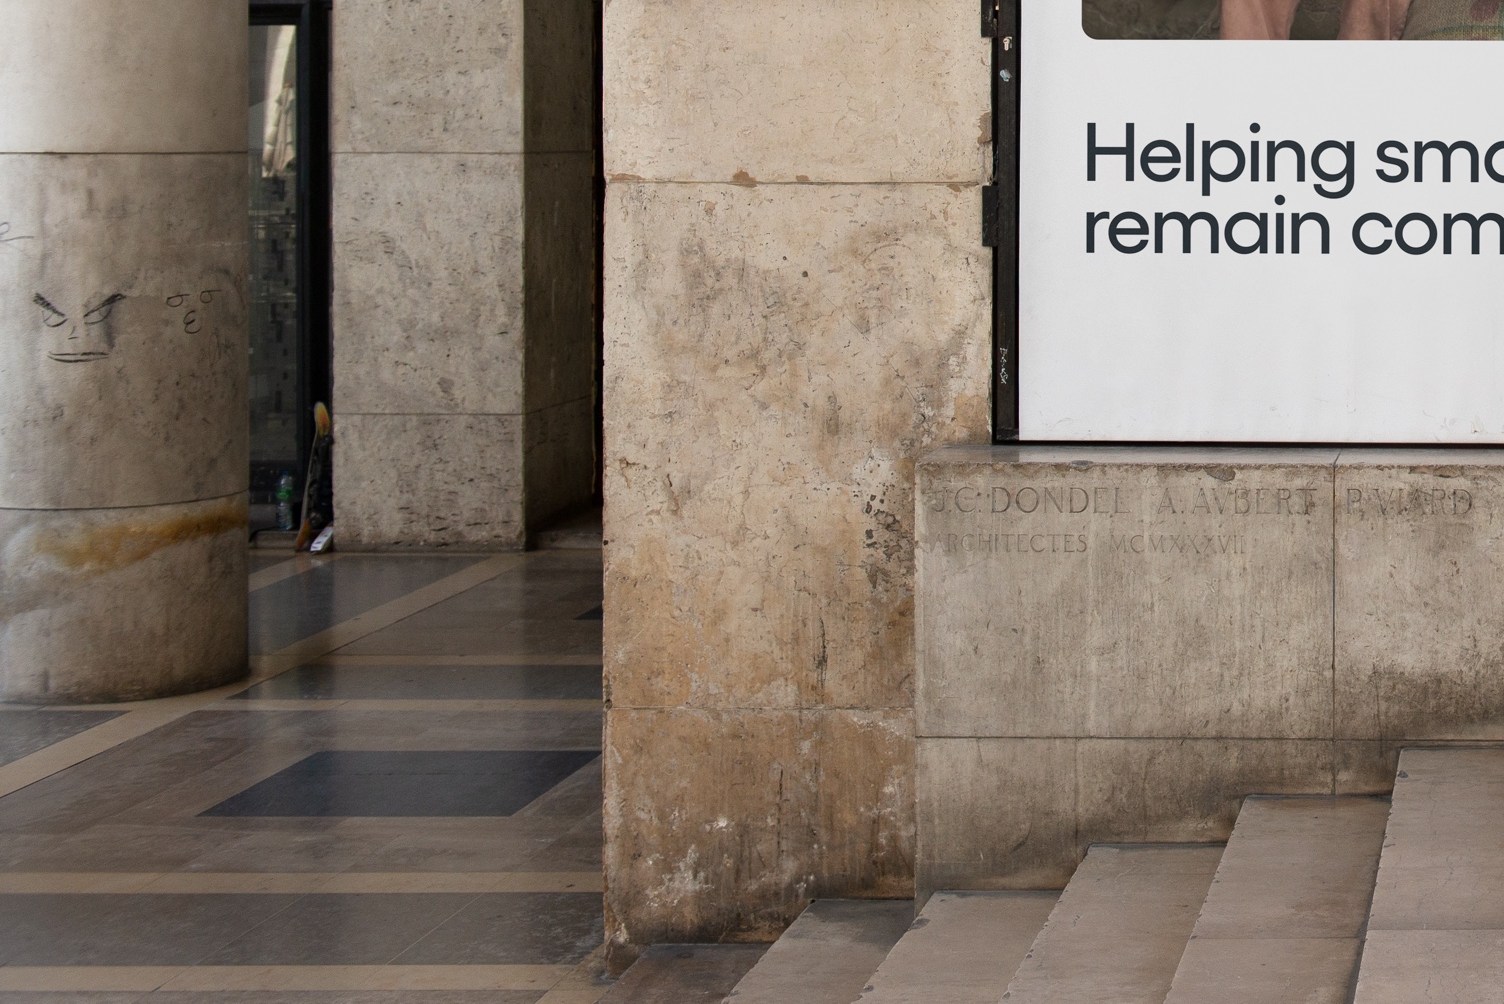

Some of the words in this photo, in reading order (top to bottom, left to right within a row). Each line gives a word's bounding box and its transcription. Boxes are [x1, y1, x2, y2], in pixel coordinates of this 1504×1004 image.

[1086, 122, 1356, 199] Helping
[1086, 195, 1330, 254] remain
[931, 534, 1088, 553] ARCHITECTES
